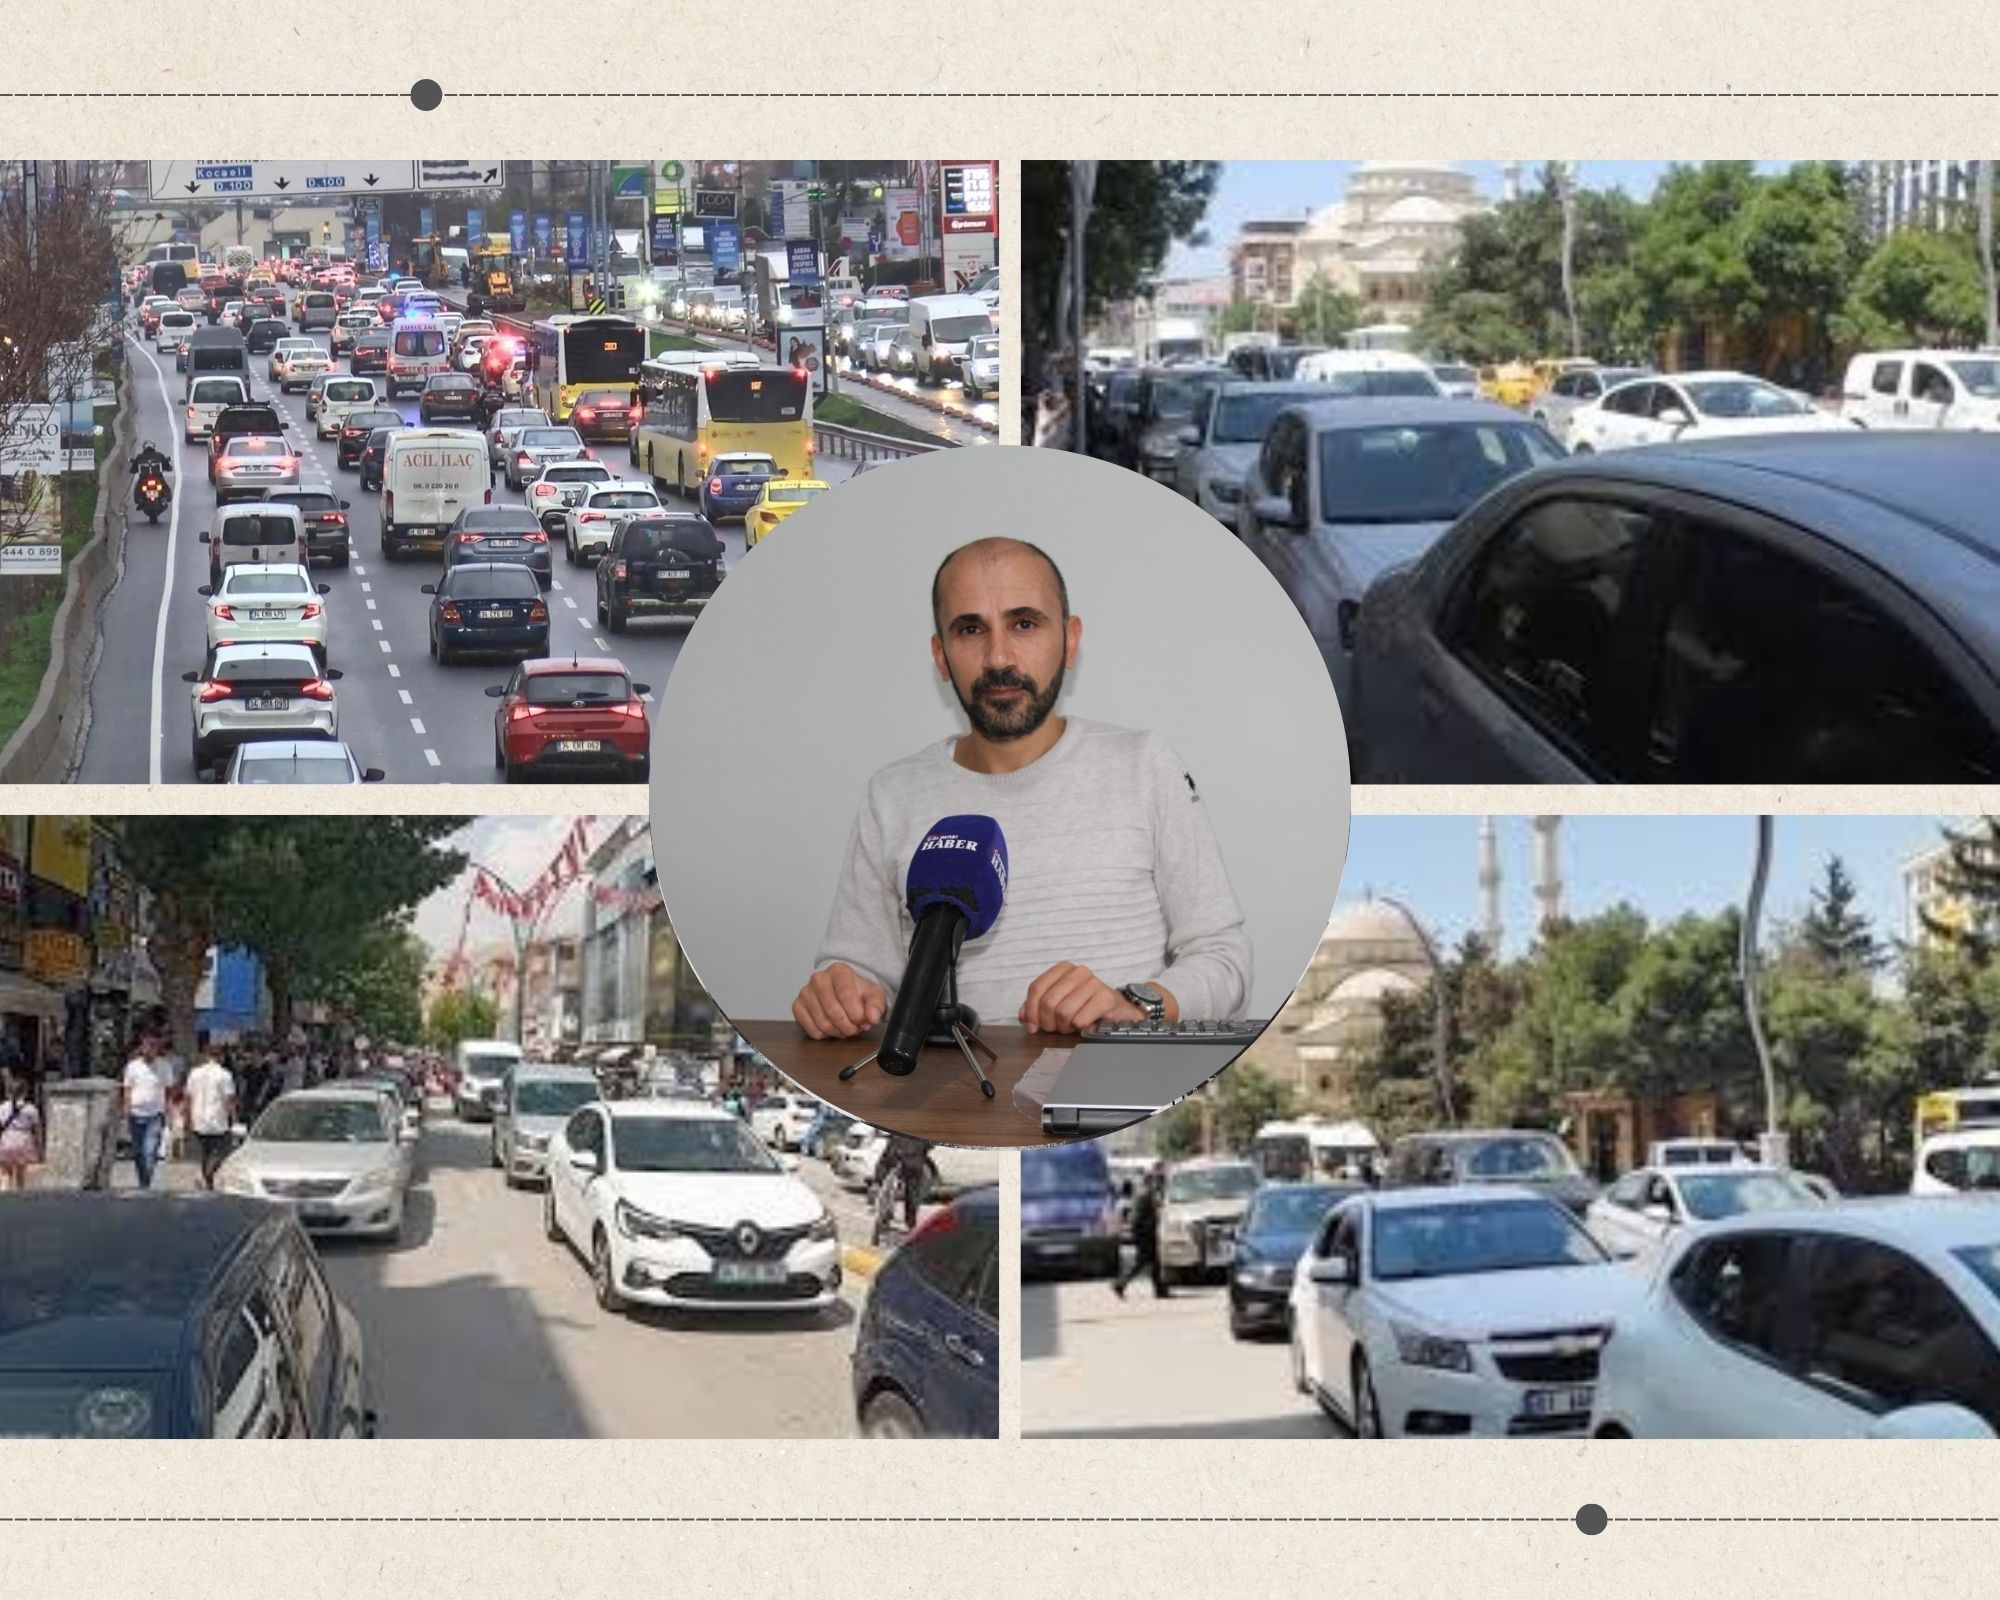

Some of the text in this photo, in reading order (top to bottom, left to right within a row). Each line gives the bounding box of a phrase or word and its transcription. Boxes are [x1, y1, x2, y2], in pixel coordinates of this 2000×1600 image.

[196, 168, 247, 178] Kocaeli
[215, 182, 251, 191] D.100
[307, 178, 344, 187] D.100
[39, 548, 60, 556] 899
[921, 840, 978, 851] HABER
